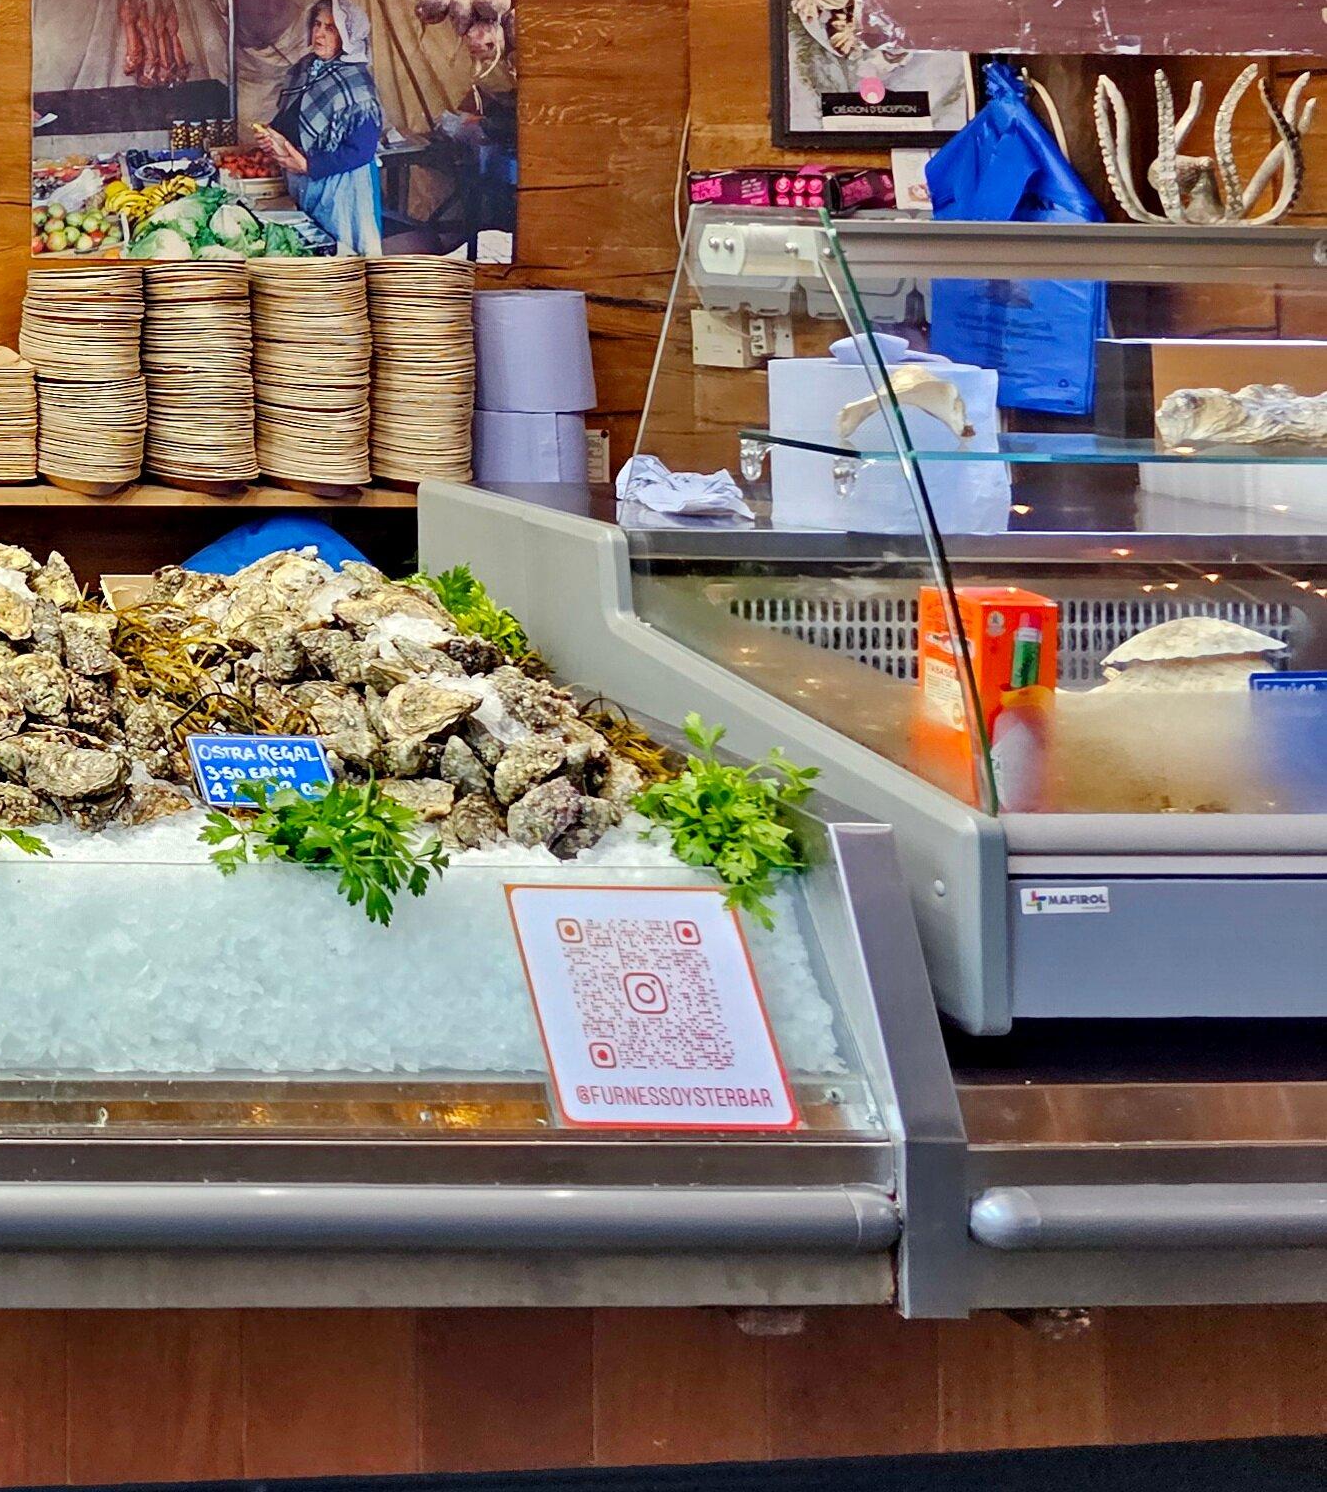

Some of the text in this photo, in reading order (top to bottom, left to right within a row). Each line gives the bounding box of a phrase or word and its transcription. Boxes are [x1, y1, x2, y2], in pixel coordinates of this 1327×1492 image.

[197, 743, 320, 767] OSTRA REGAL
[248, 765, 297, 779] EACH
[210, 782, 228, 800] 4
[1048, 894, 1107, 905] MAFIROL
[575, 1085, 775, 1108] @FURNESSOYSTERBAR
